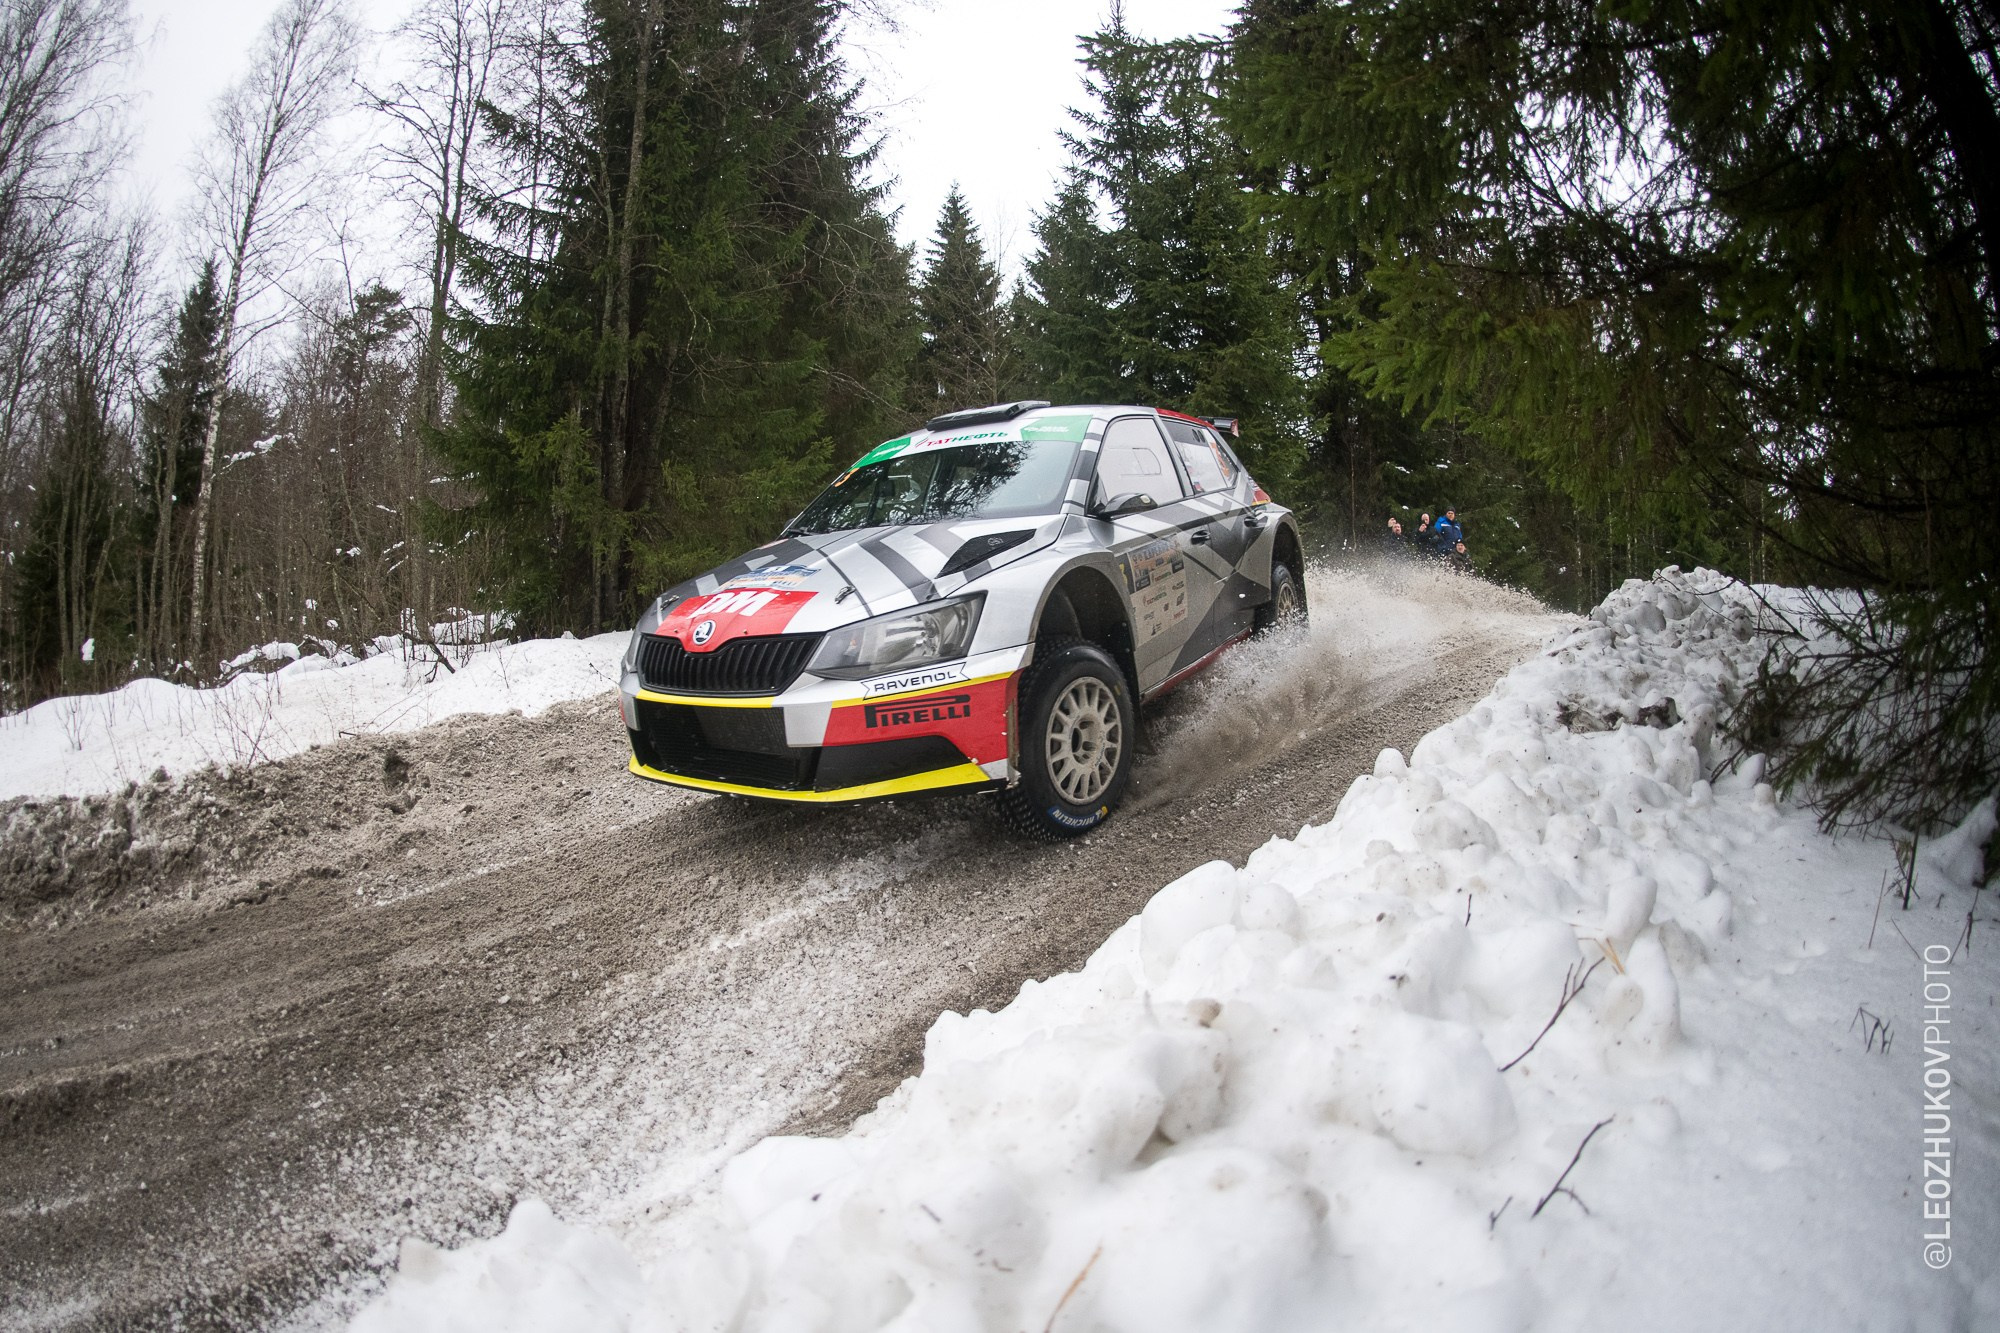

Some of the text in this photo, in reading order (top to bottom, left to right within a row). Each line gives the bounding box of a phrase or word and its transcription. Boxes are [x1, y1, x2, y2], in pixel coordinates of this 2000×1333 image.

[926, 431, 1009, 448] ТАТНЕФТЬ
[874, 671, 957, 692] RAVENOL
[863, 694, 971, 729] PIRELLI
[1052, 808, 1095, 827] MICHELIN
